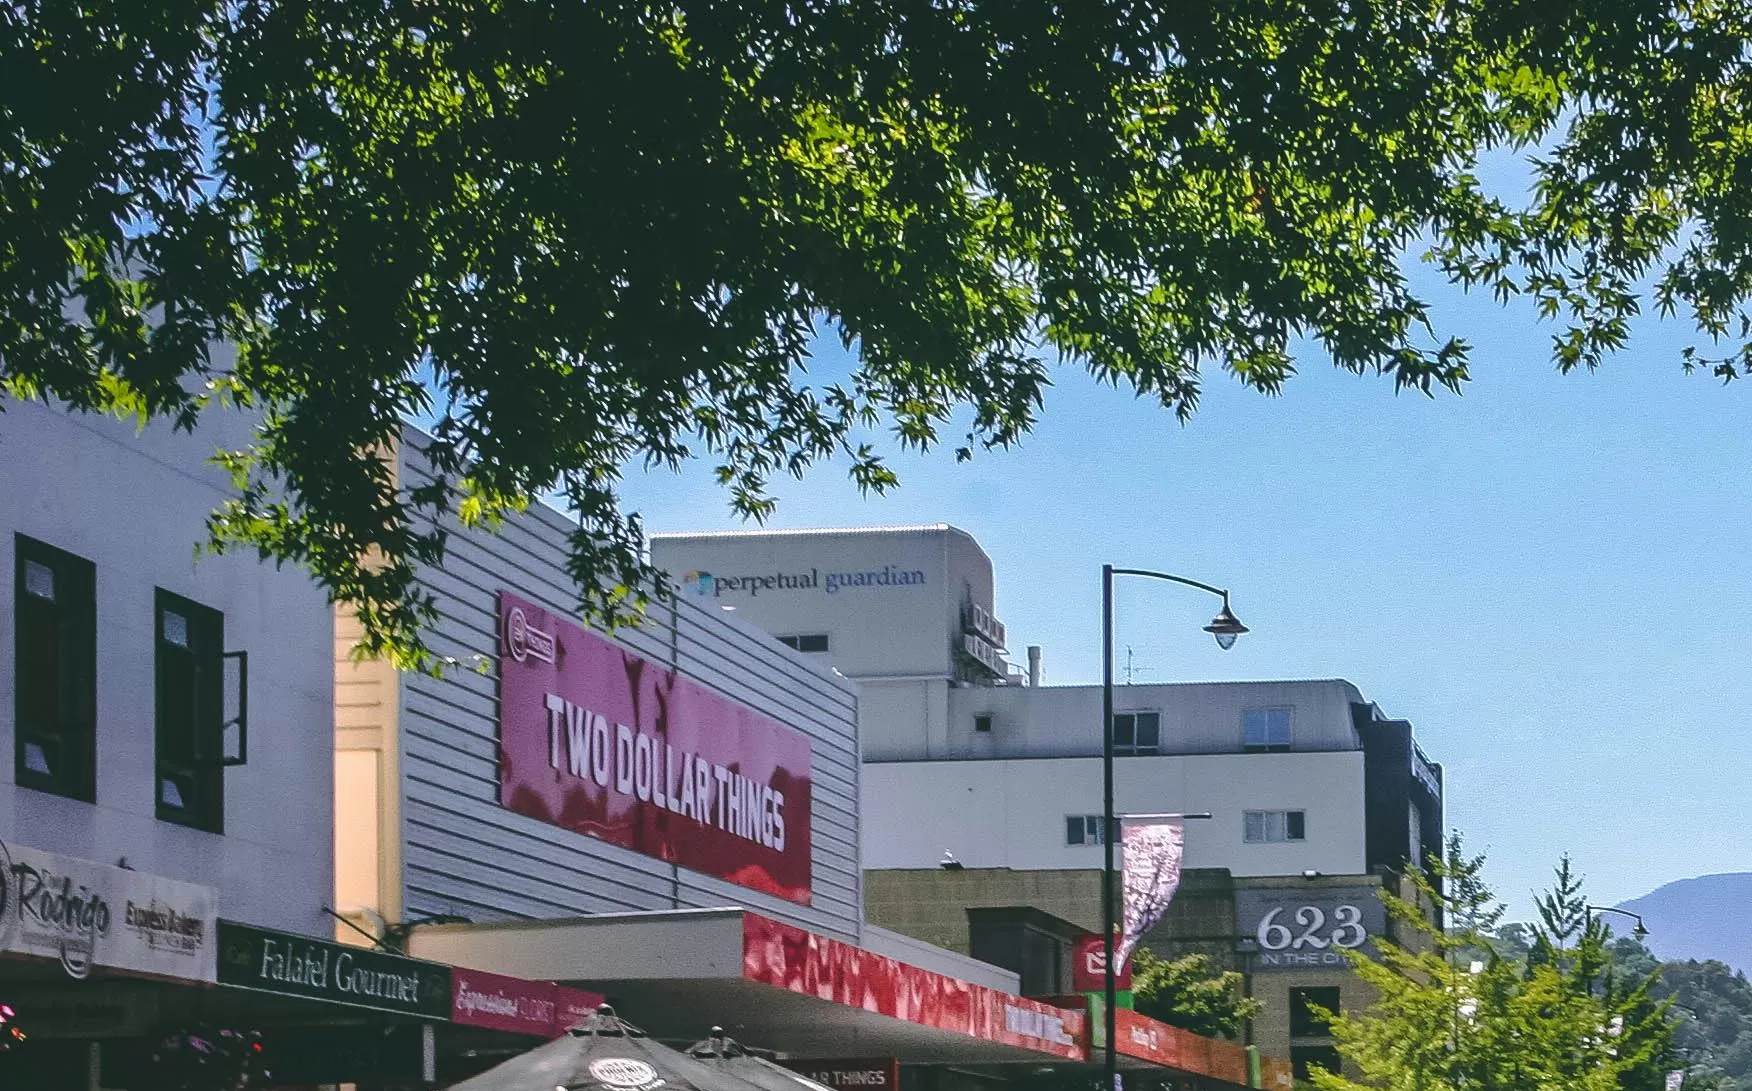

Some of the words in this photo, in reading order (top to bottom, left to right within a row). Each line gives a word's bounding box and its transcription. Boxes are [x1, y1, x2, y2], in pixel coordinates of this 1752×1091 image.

[714, 568, 818, 597] perpetual
[825, 565, 926, 594] guardian
[546, 692, 610, 787] TWO
[615, 722, 712, 825] DOLLAR
[713, 763, 786, 853] THINGS
[1257, 904, 1367, 950] 623
[259, 938, 329, 988] Falafel
[335, 952, 419, 1003] Gourmet
[1283, 952, 1318, 965] THE
[832, 1070, 886, 1085] THINGS
